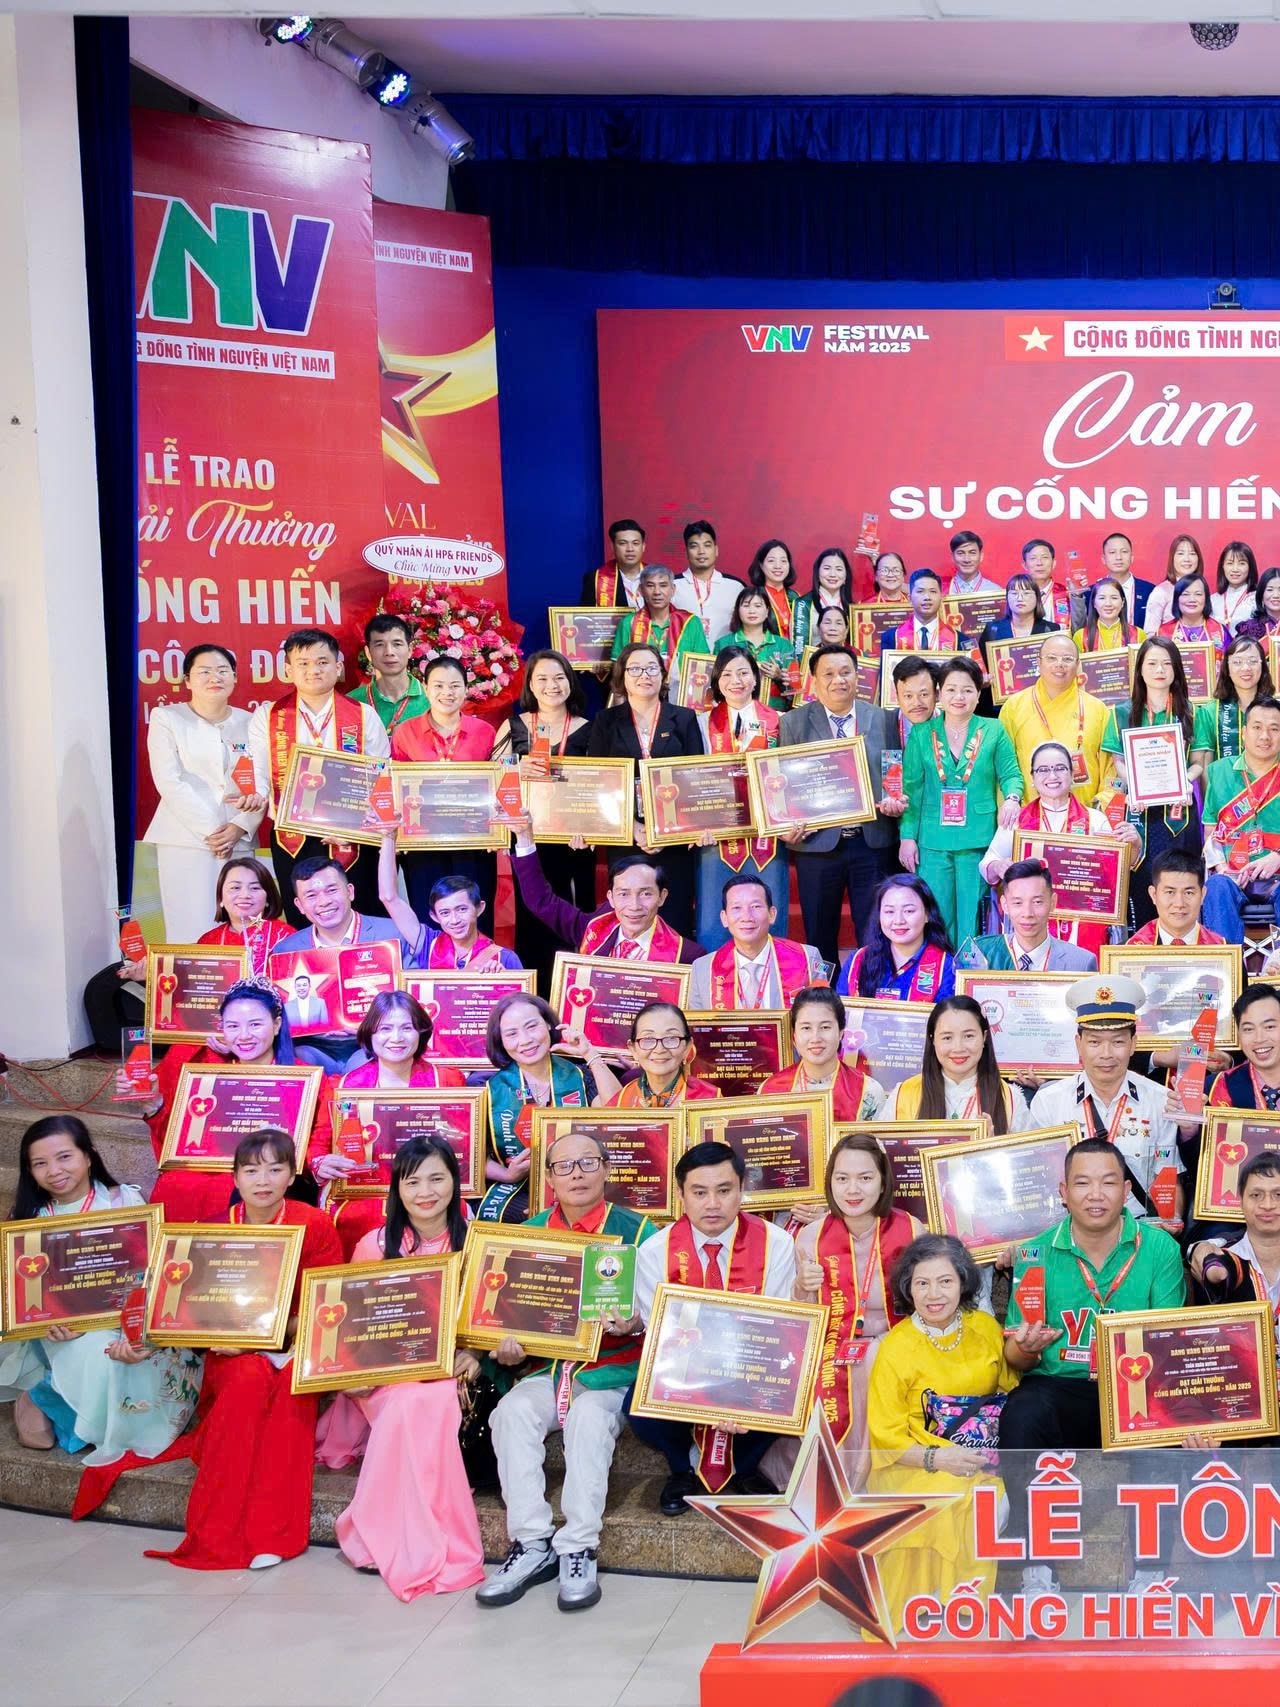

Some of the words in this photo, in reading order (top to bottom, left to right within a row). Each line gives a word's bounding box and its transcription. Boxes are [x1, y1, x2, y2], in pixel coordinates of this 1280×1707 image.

[374, 241, 391, 259] ÌNH
[429, 250, 448, 266] VIỆT
[449, 253, 470, 268] NAM
[741, 324, 813, 352] VNV
[823, 324, 930, 341] FESTIVAL
[824, 339, 865, 353] NĂM
[868, 340, 911, 353] 2025
[1073, 325, 1128, 353] CỘNG
[1134, 323, 1190, 349] ĐỒNG
[1198, 323, 1242, 349] TÌNH
[147, 338, 183, 359] ĐỒNG
[187, 342, 216, 363] TÌNH
[219, 349, 269, 370] NGUYỆN
[272, 354, 298, 372] VIỆT
[301, 357, 330, 373] NAM
[1042, 370, 1258, 470] Cảm
[145, 437, 181, 486] LỄ
[189, 454, 276, 491] TRAO
[889, 481, 977, 528] SỰ
[986, 474, 1148, 521] CỐNG
[186, 499, 338, 561] Thưởng
[374, 543, 394, 557] QUỸ
[396, 545, 422, 558] NHÂN
[455, 551, 493, 563] FRIENDS
[454, 565, 478, 576] VNV
[238, 564, 342, 626] HIẾN
[917, 963, 935, 994] VNV
[831, 1289, 849, 1316] CỐNG
[823, 1398, 839, 1424] 2025
[973, 1452, 1084, 1560] LỄ
[902, 1577, 1069, 1641] CỐNG
[1082, 1577, 1217, 1640] HIẾN
